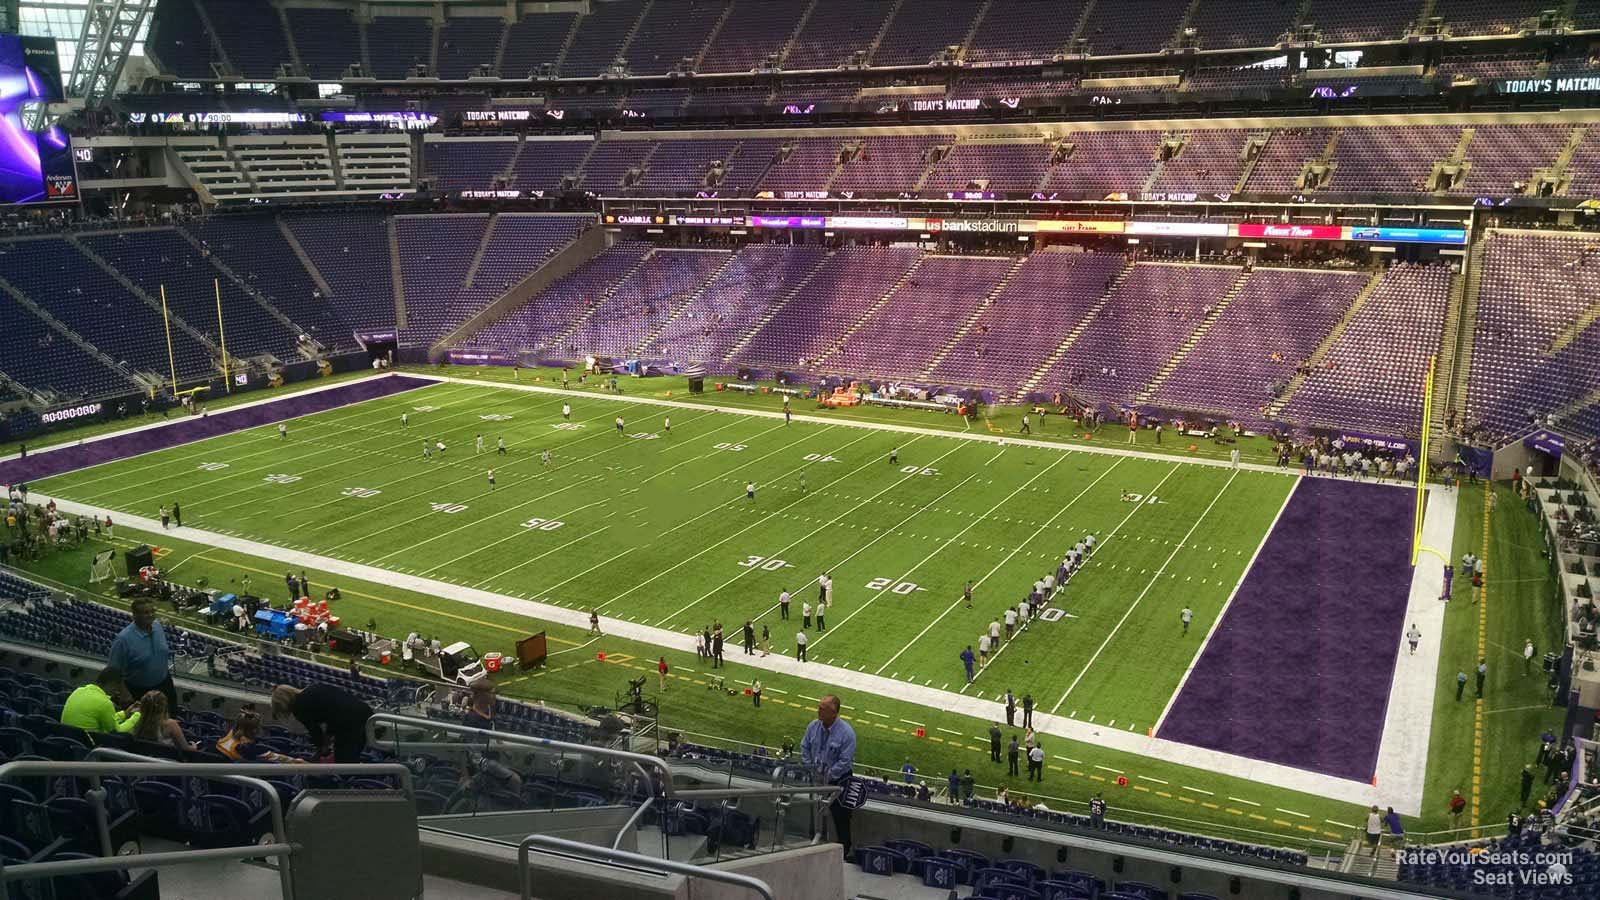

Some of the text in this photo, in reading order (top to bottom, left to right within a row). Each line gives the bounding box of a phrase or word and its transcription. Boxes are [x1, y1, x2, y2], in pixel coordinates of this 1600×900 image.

[1506, 80, 1552, 93] TODAY'S
[913, 100, 980, 110] TODAY'S MATCHUP
[466, 111, 530, 120] TODAY'S MATCHUP
[76, 151, 91, 161] 40
[520, 517, 565, 531] 50
[737, 555, 787, 571] 30
[864, 577, 918, 595] 20
[846, 781, 862, 808] WAIT
